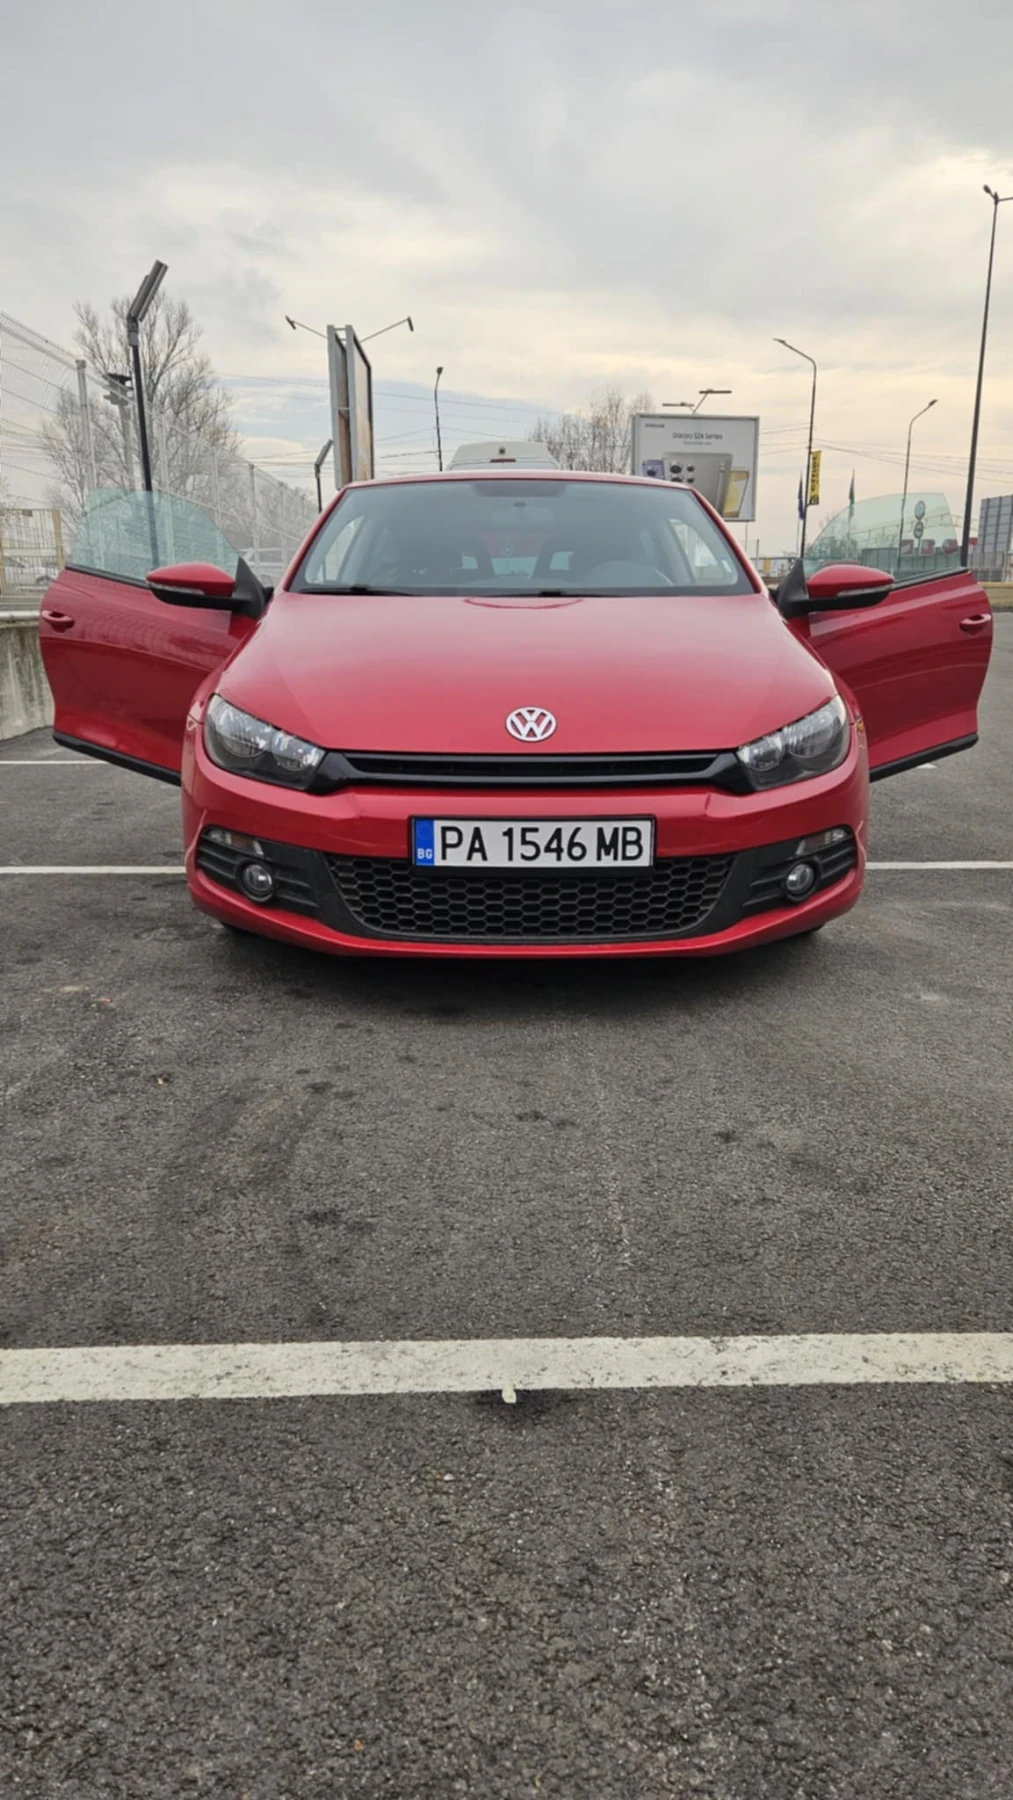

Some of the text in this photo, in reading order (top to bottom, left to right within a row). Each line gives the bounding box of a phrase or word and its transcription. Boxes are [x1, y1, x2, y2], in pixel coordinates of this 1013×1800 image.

[506, 706, 557, 742] VW
[417, 848, 433, 859] BG
[440, 826, 644, 862] PA 1546 MB
